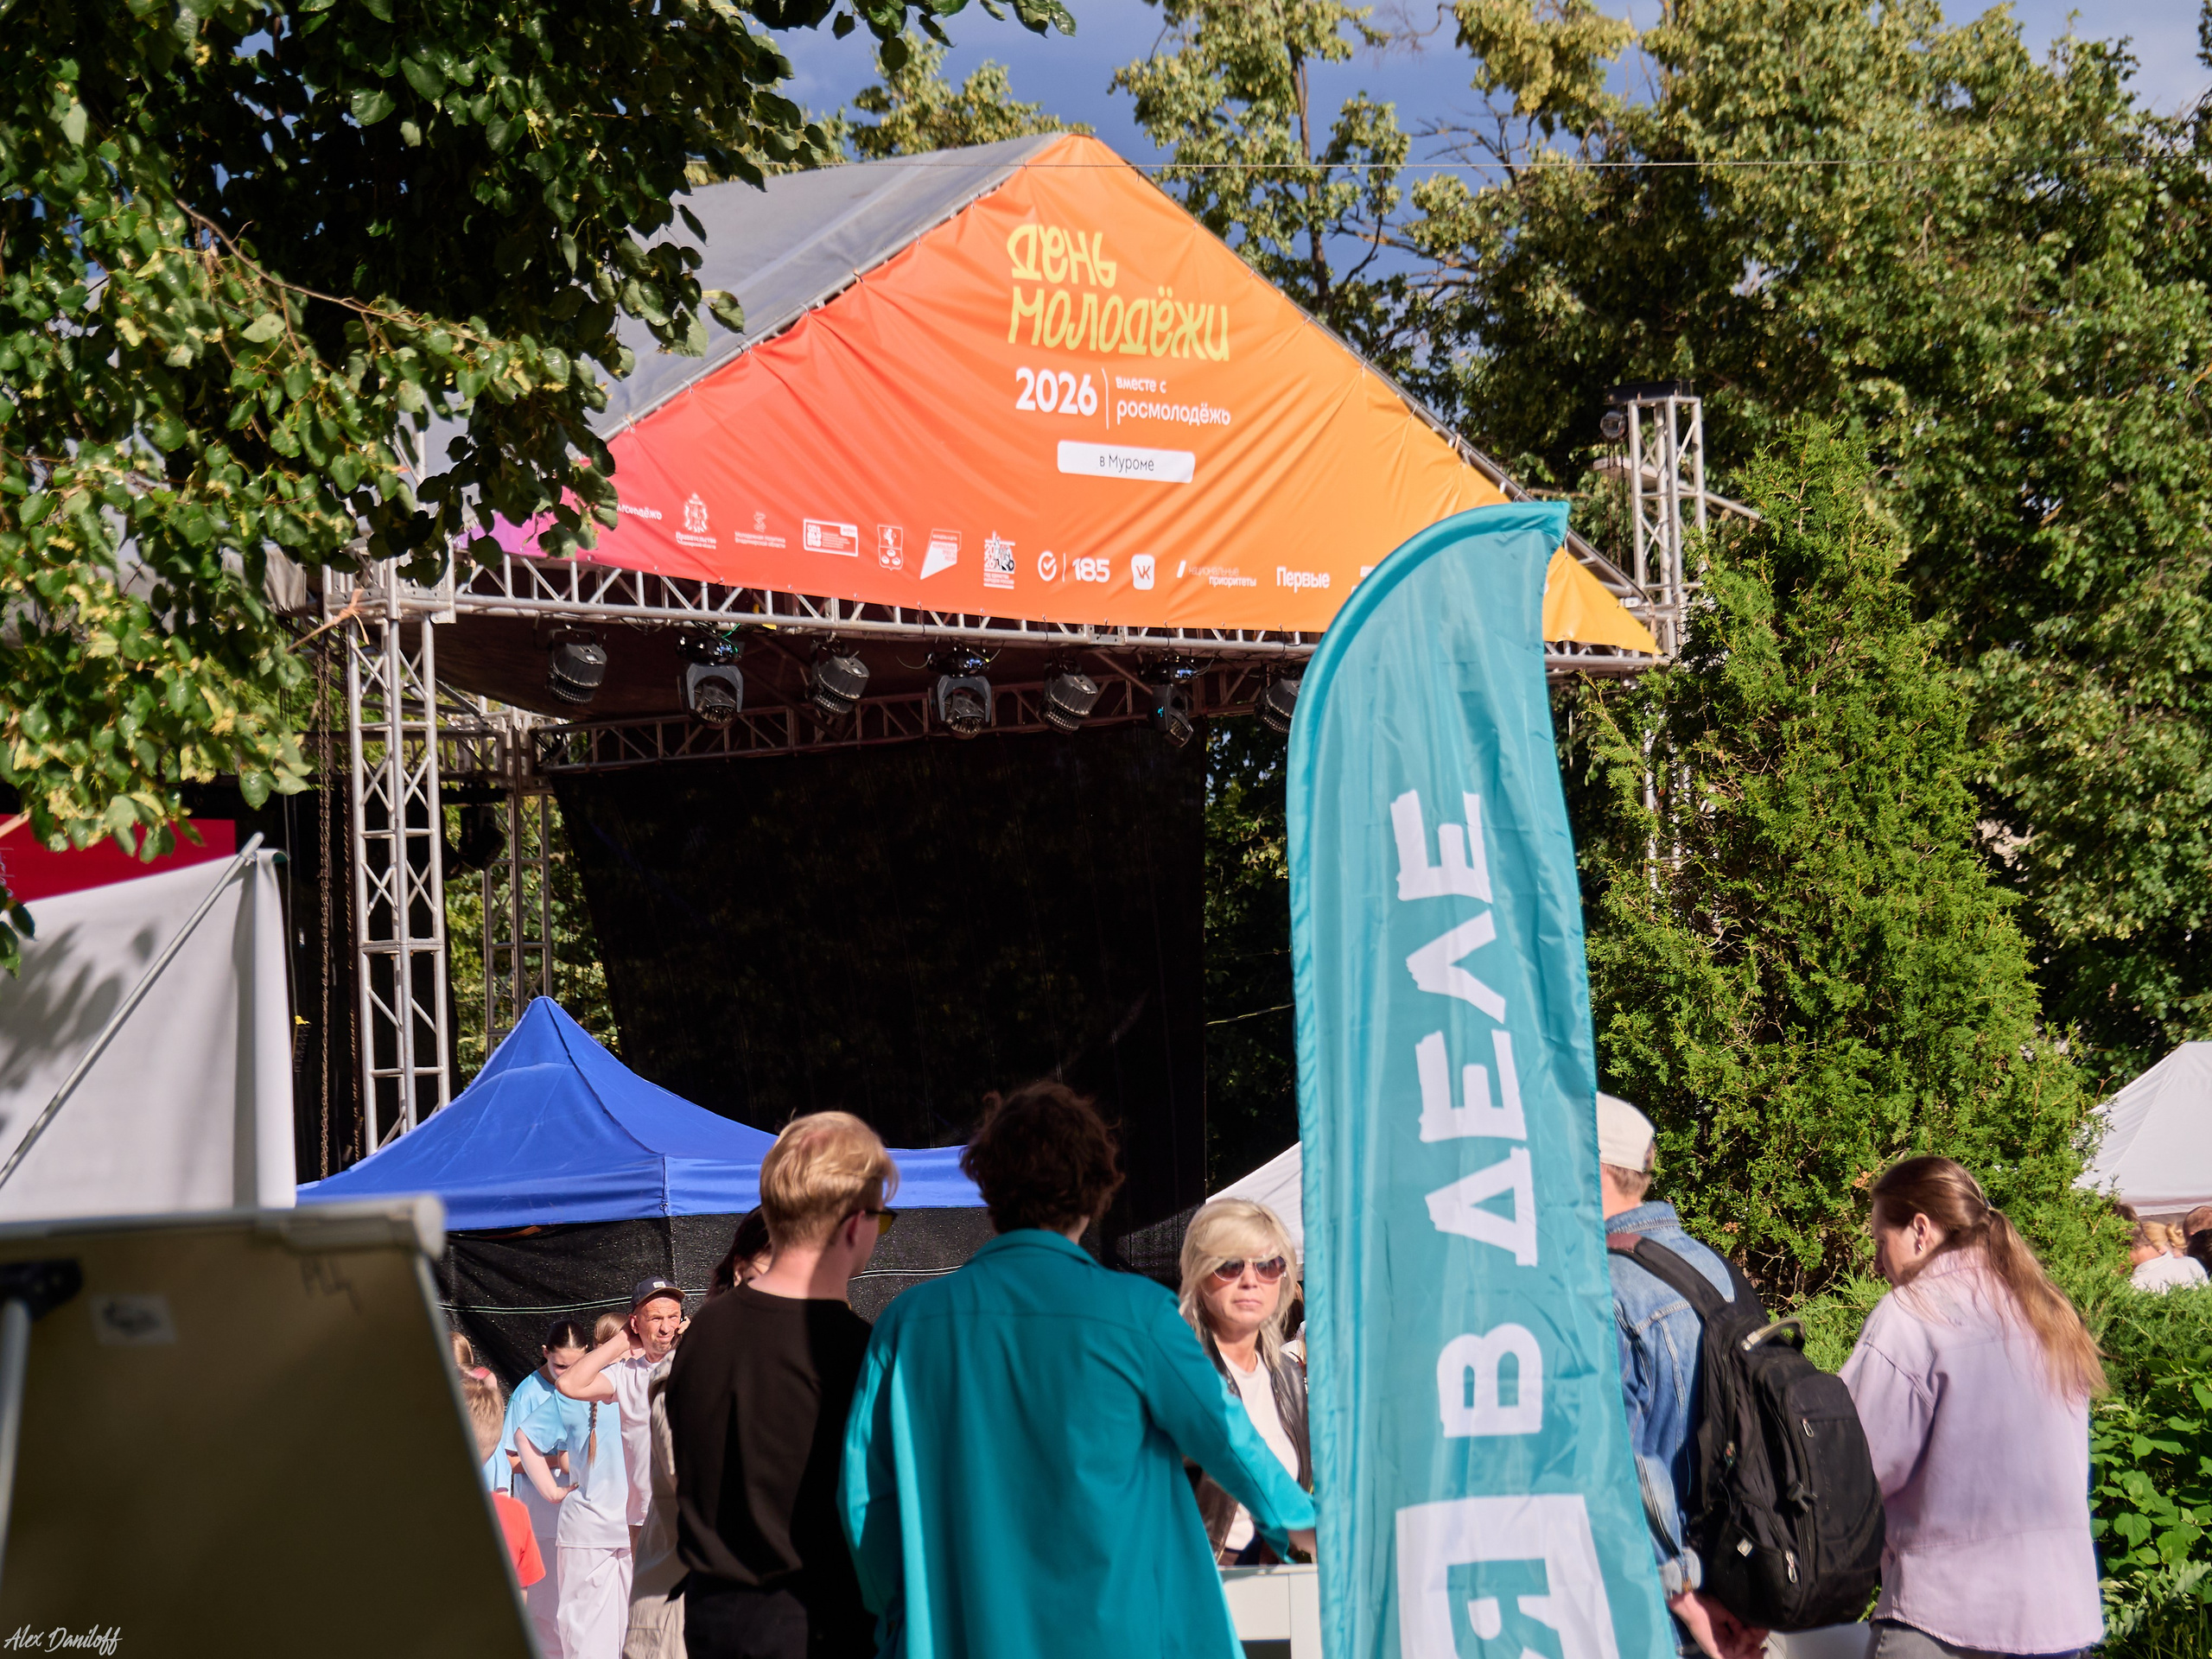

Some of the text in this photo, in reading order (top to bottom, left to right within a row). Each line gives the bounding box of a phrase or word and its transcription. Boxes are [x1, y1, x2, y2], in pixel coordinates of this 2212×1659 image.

[1015, 366, 1097, 416] 2026
[1115, 376, 1166, 394] вместе с
[1116, 399, 1231, 427] росмолодёжь
[1099, 454, 1154, 474] в Муроме
[1072, 557, 1110, 583] 185
[1136, 565, 1151, 580] VK
[1209, 575, 1257, 588] приоритеты
[1276, 566, 1331, 594] Первые
[1389, 788, 1539, 1268] ДЕЛЕ
[1436, 1322, 1543, 1439] В
